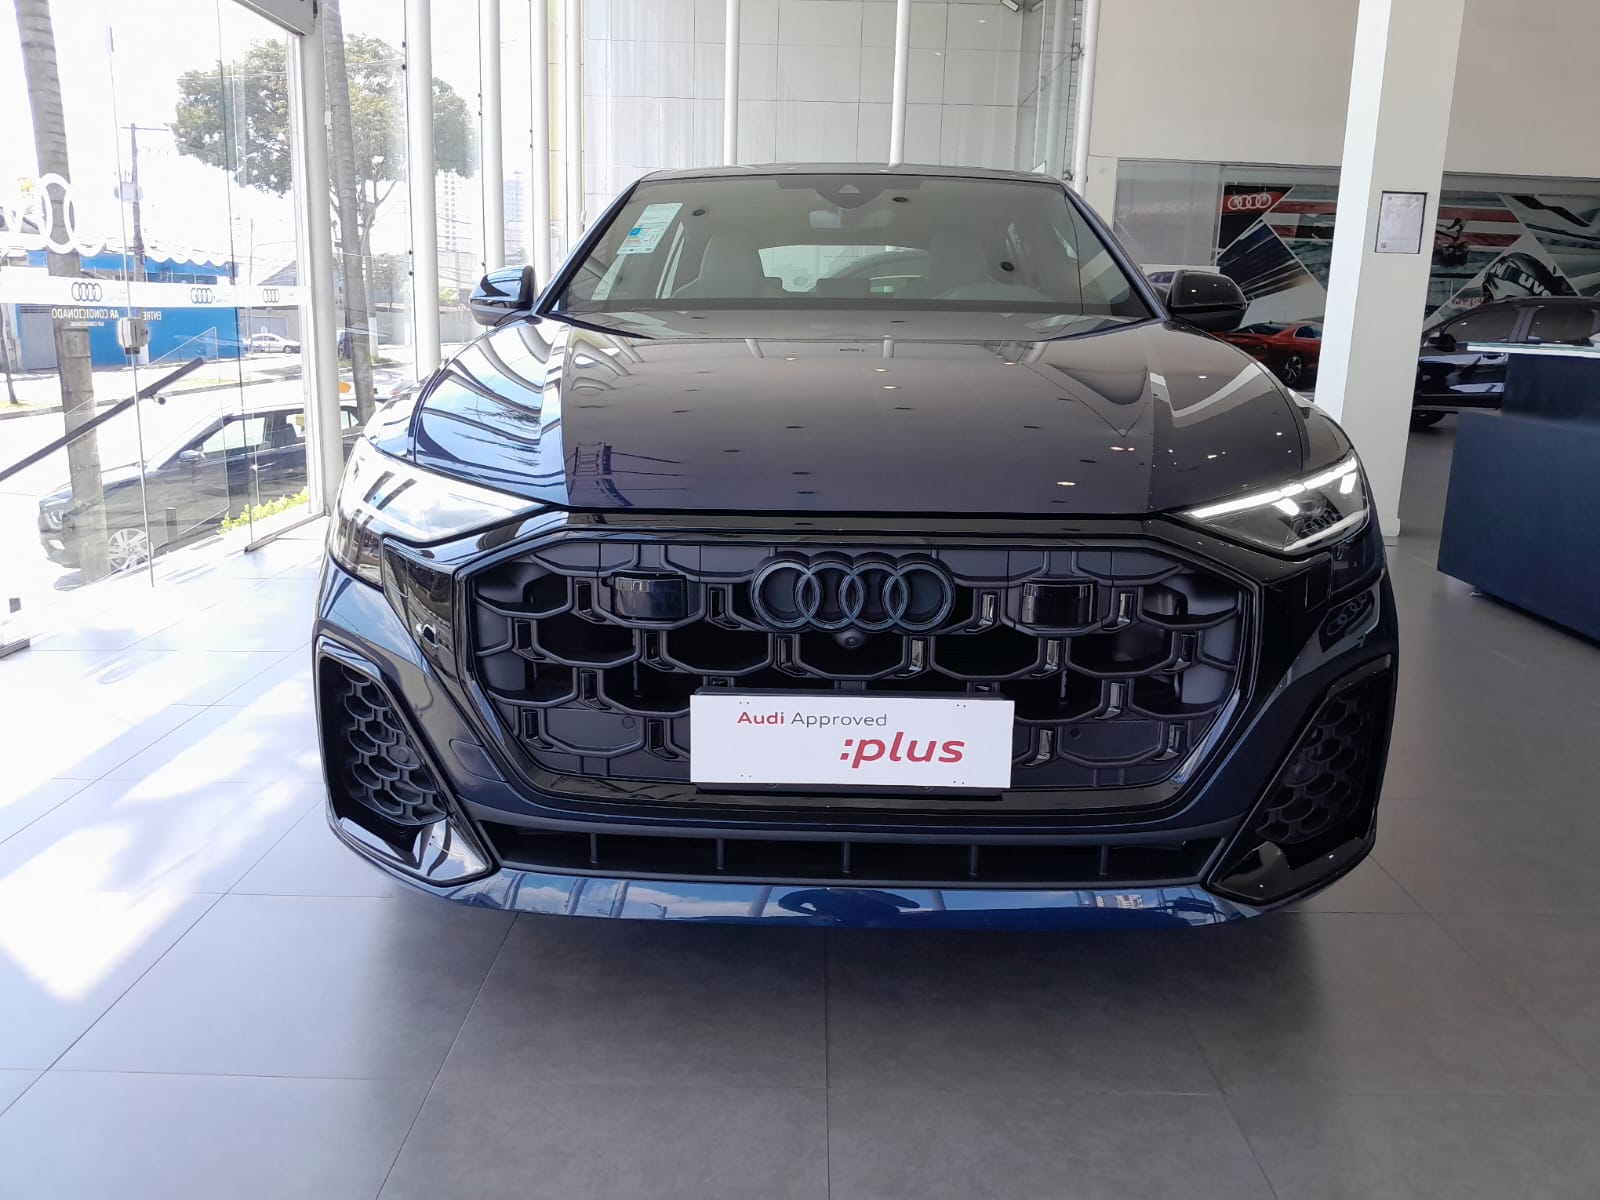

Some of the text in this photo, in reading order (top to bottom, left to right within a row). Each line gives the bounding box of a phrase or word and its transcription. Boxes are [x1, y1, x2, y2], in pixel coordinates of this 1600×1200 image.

[737, 711, 888, 729] Audi Approved
[839, 731, 967, 769] :plus
